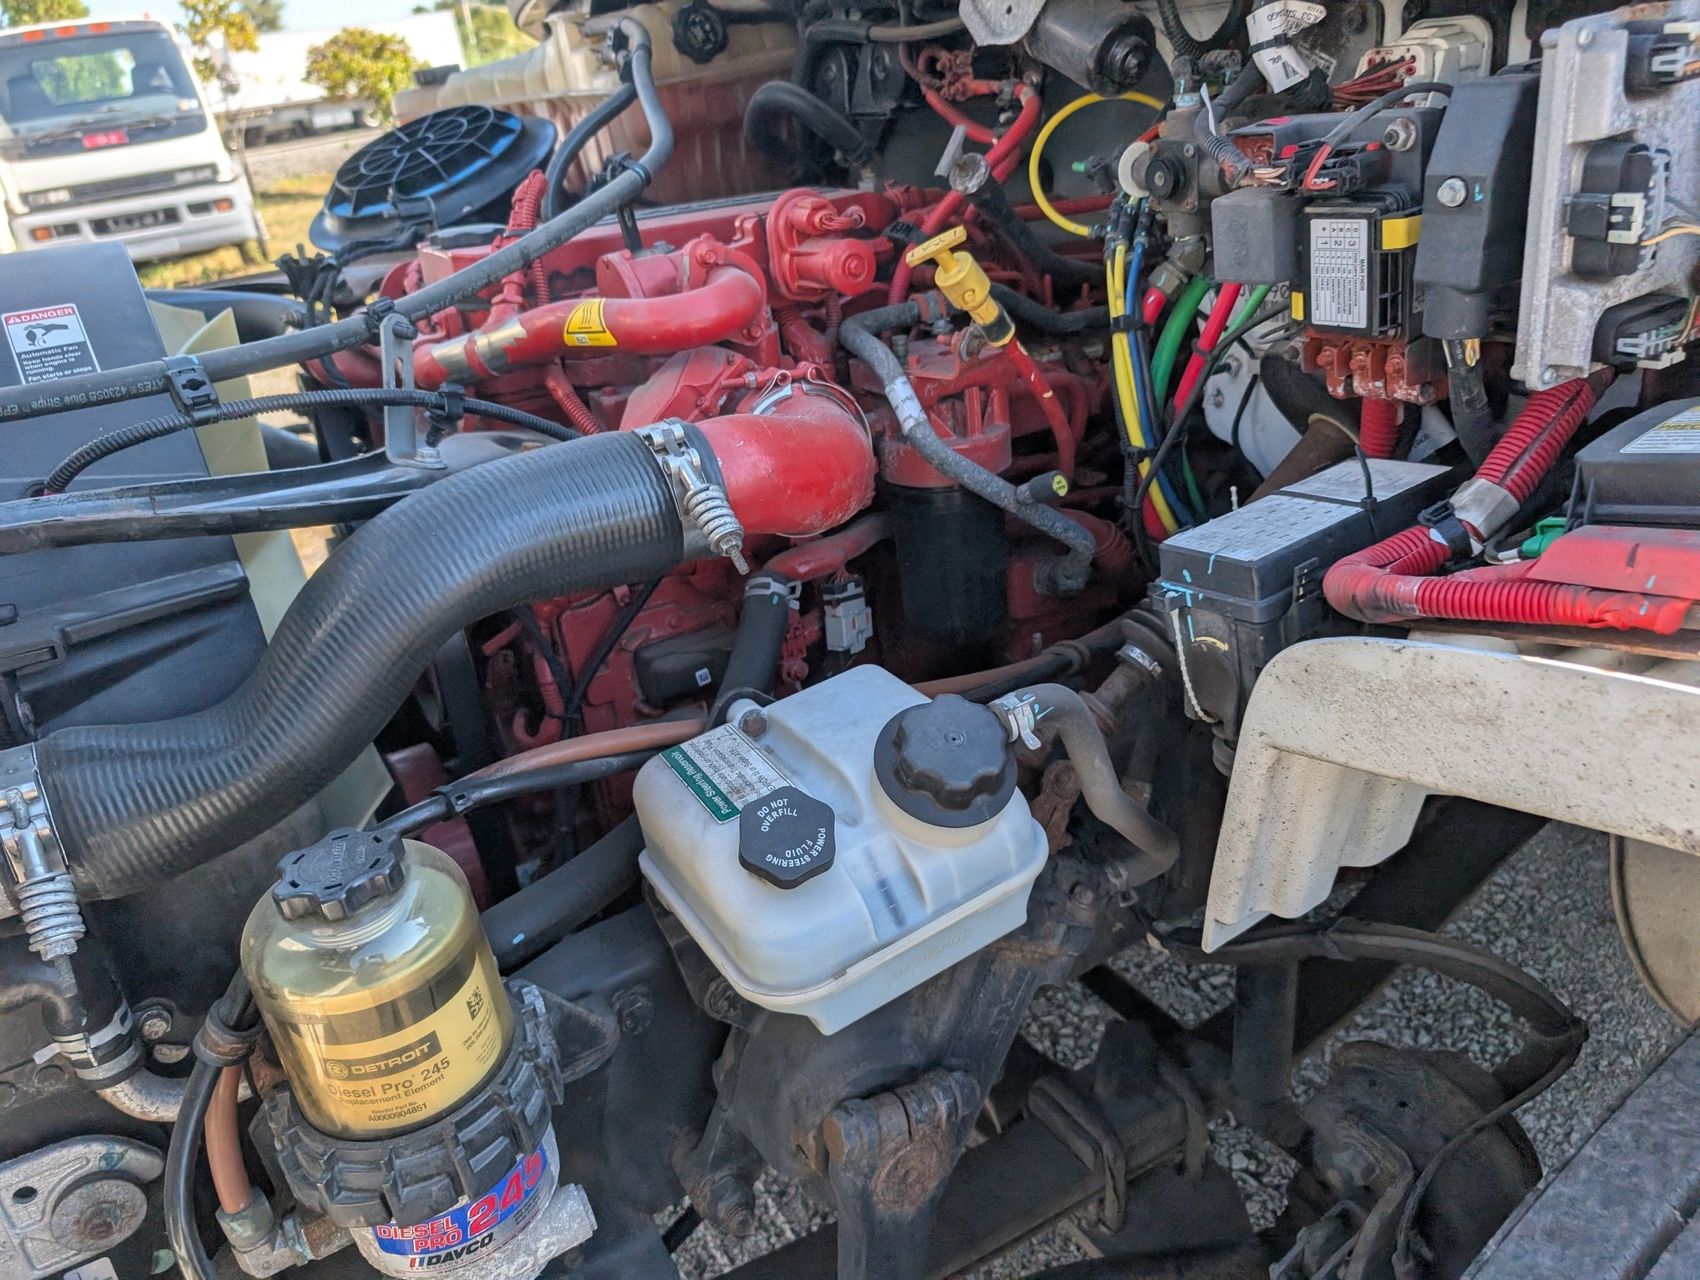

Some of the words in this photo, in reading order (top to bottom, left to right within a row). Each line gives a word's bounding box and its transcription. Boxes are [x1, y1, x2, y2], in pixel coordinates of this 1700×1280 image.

[21, 307, 73, 322] DANGER
[21, 347, 62, 359] Automatic
[63, 345, 78, 353] Fan
[42, 354, 63, 362] hands
[26, 366, 55, 375] running.
[42, 371, 63, 379] starts
[89, 386, 127, 401] 4230SB
[129, 377, 165, 393] ATES®
[64, 393, 86, 404] Blue
[671, 751, 696, 775] Reservoir
[693, 773, 715, 797] Steering
[712, 795, 733, 814] Power
[757, 806, 769, 818] DO
[770, 799, 789, 809] NOT
[761, 807, 798, 832] OVERFILL
[785, 839, 813, 858] FLUID
[811, 828, 826, 857] POWER
[766, 854, 811, 867] STEERING
[351, 1042, 431, 1074] DETROIT
[327, 1084, 376, 1098] Diesel
[421, 1056, 450, 1081] 245
[339, 1094, 401, 1106] Replacement
[404, 1073, 445, 1097] Element
[395, 1103, 407, 1111] Part
[377, 1216, 459, 1240] DIESEL
[467, 1150, 543, 1238] 245
[413, 1228, 463, 1253] PRO
